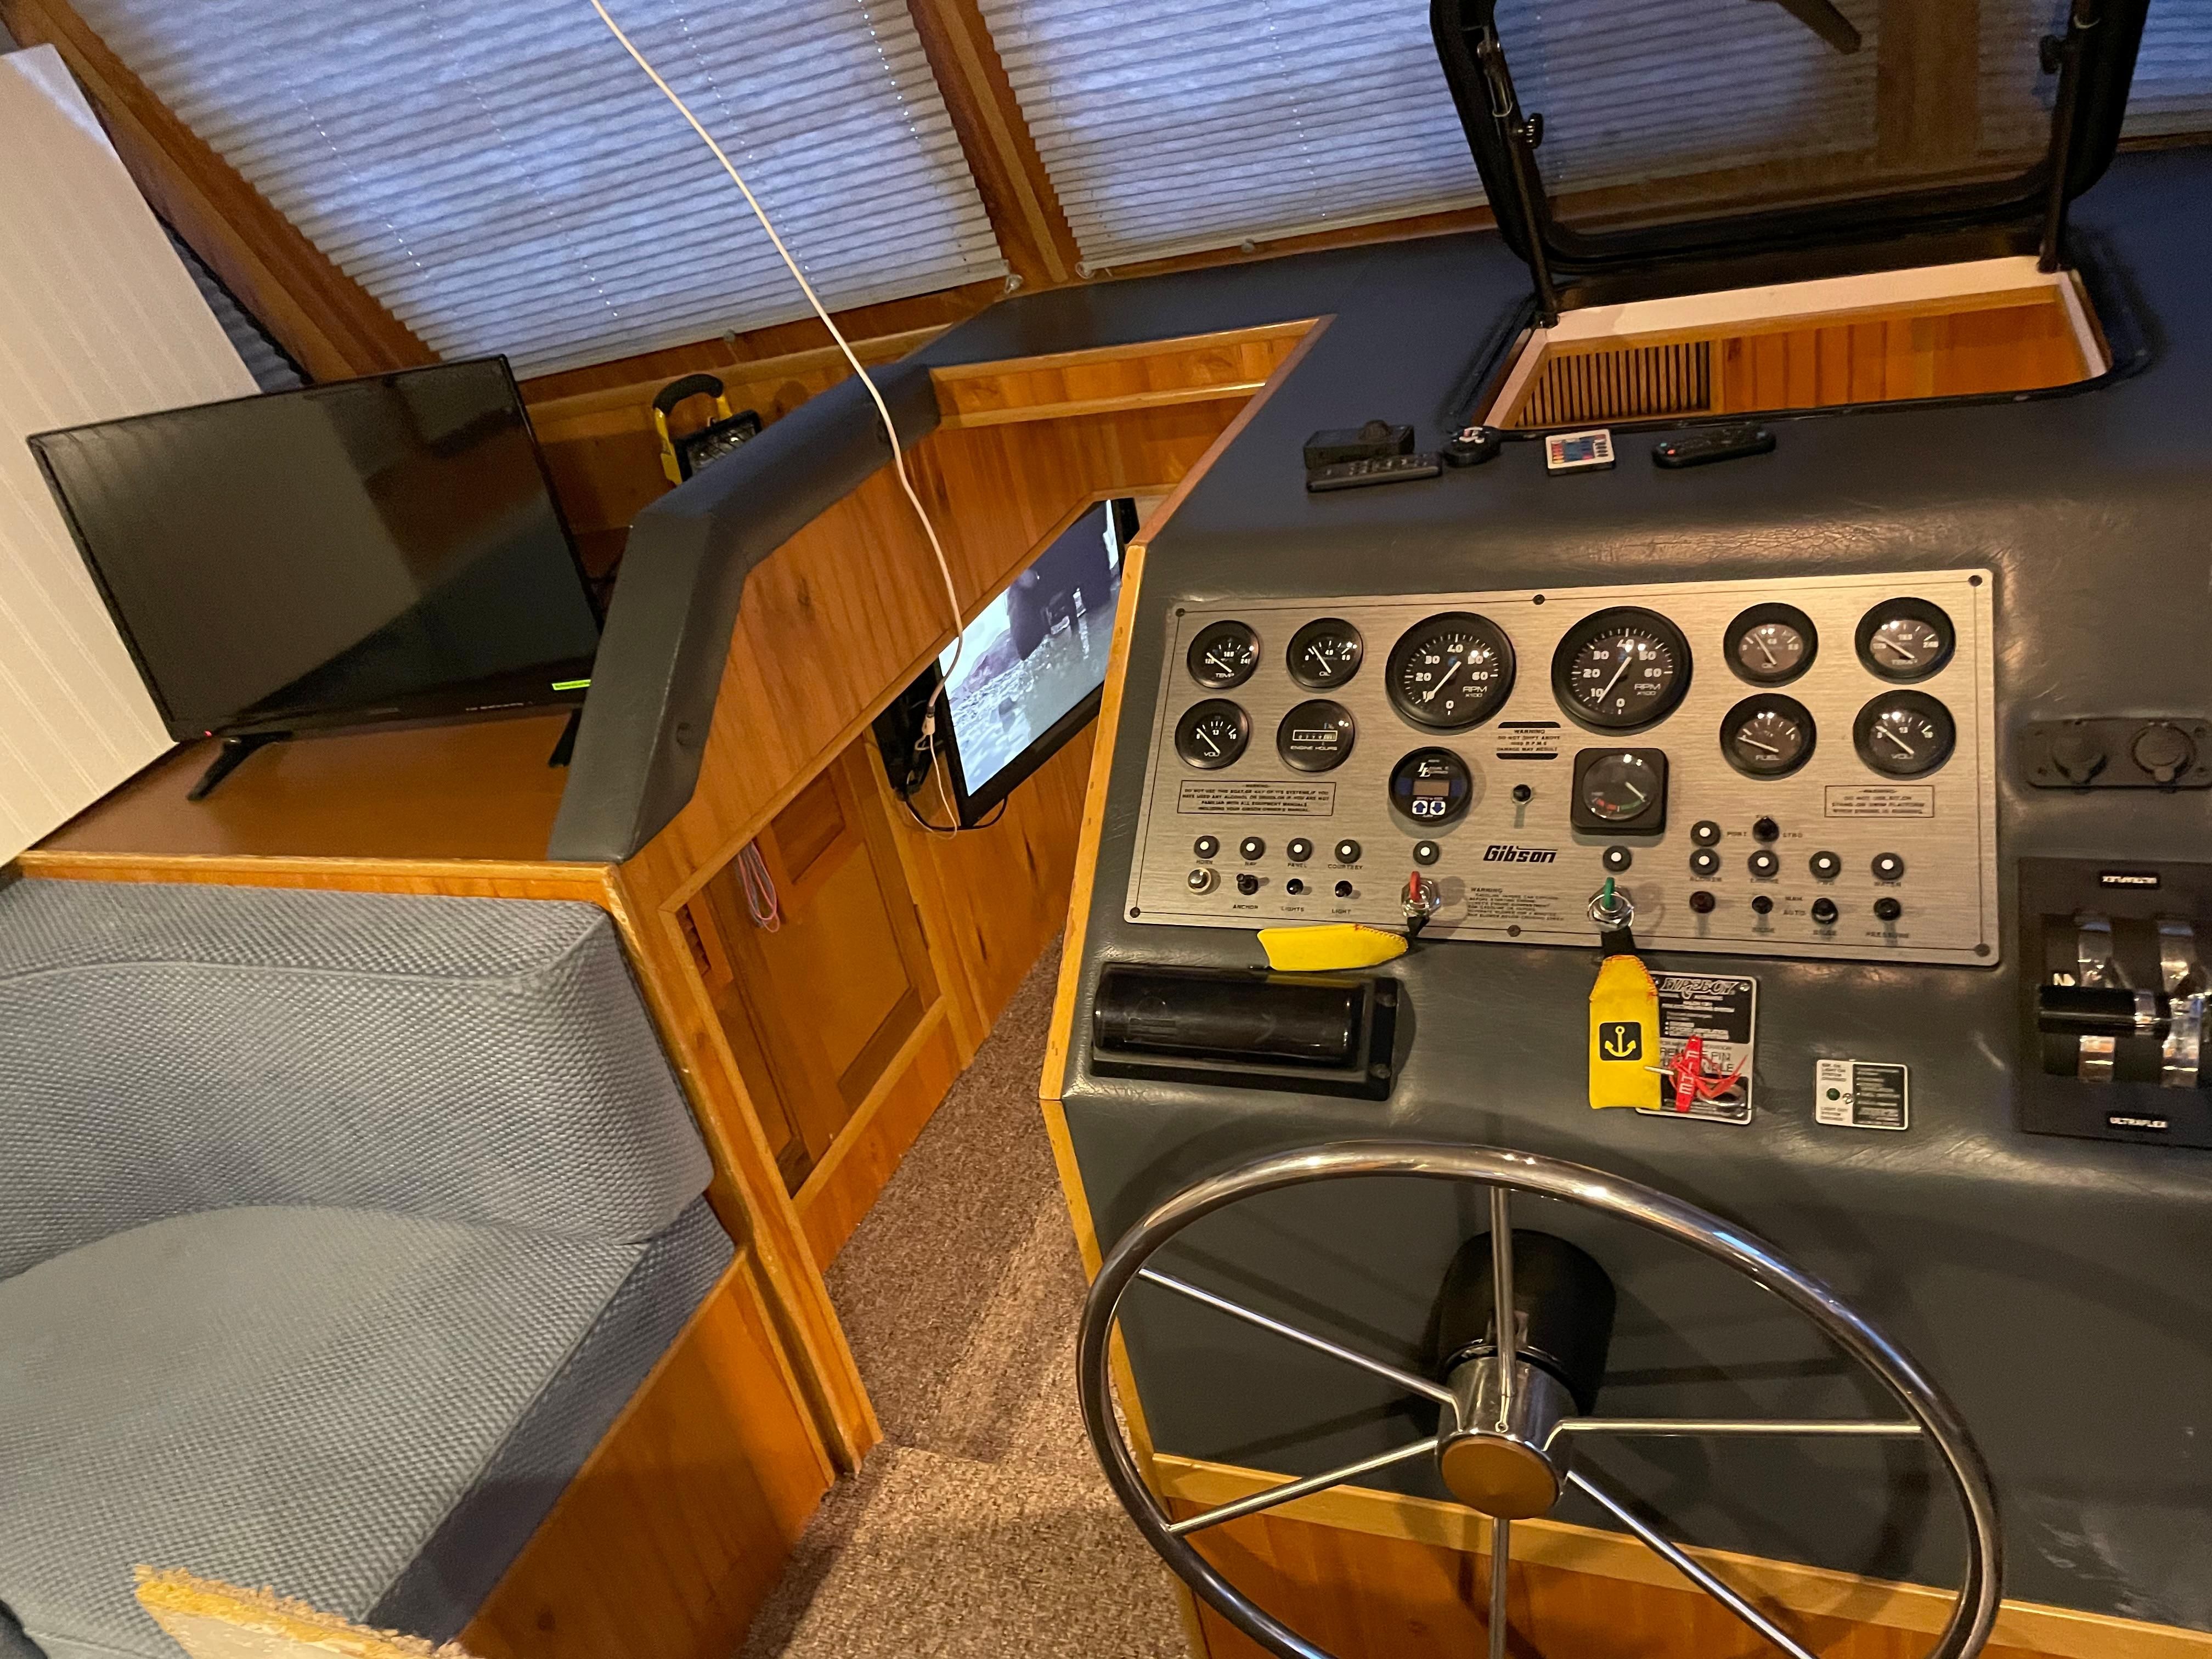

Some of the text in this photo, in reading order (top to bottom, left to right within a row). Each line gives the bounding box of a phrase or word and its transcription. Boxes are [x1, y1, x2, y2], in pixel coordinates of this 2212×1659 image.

[1447, 644, 1464, 653] 40
[1425, 655, 1440, 664] 30
[1593, 651, 1656, 661] 30 50
[1415, 672, 1488, 681] 20 60
[1583, 668, 1662, 678] 20 60
[1423, 691, 1435, 700] 10
[1591, 688, 1605, 697] 10
[1446, 700, 1454, 709] 0
[1616, 698, 1625, 707] 0
[1483, 845, 1557, 863] Gibson
[1679, 1050, 1700, 1095] FIRE
